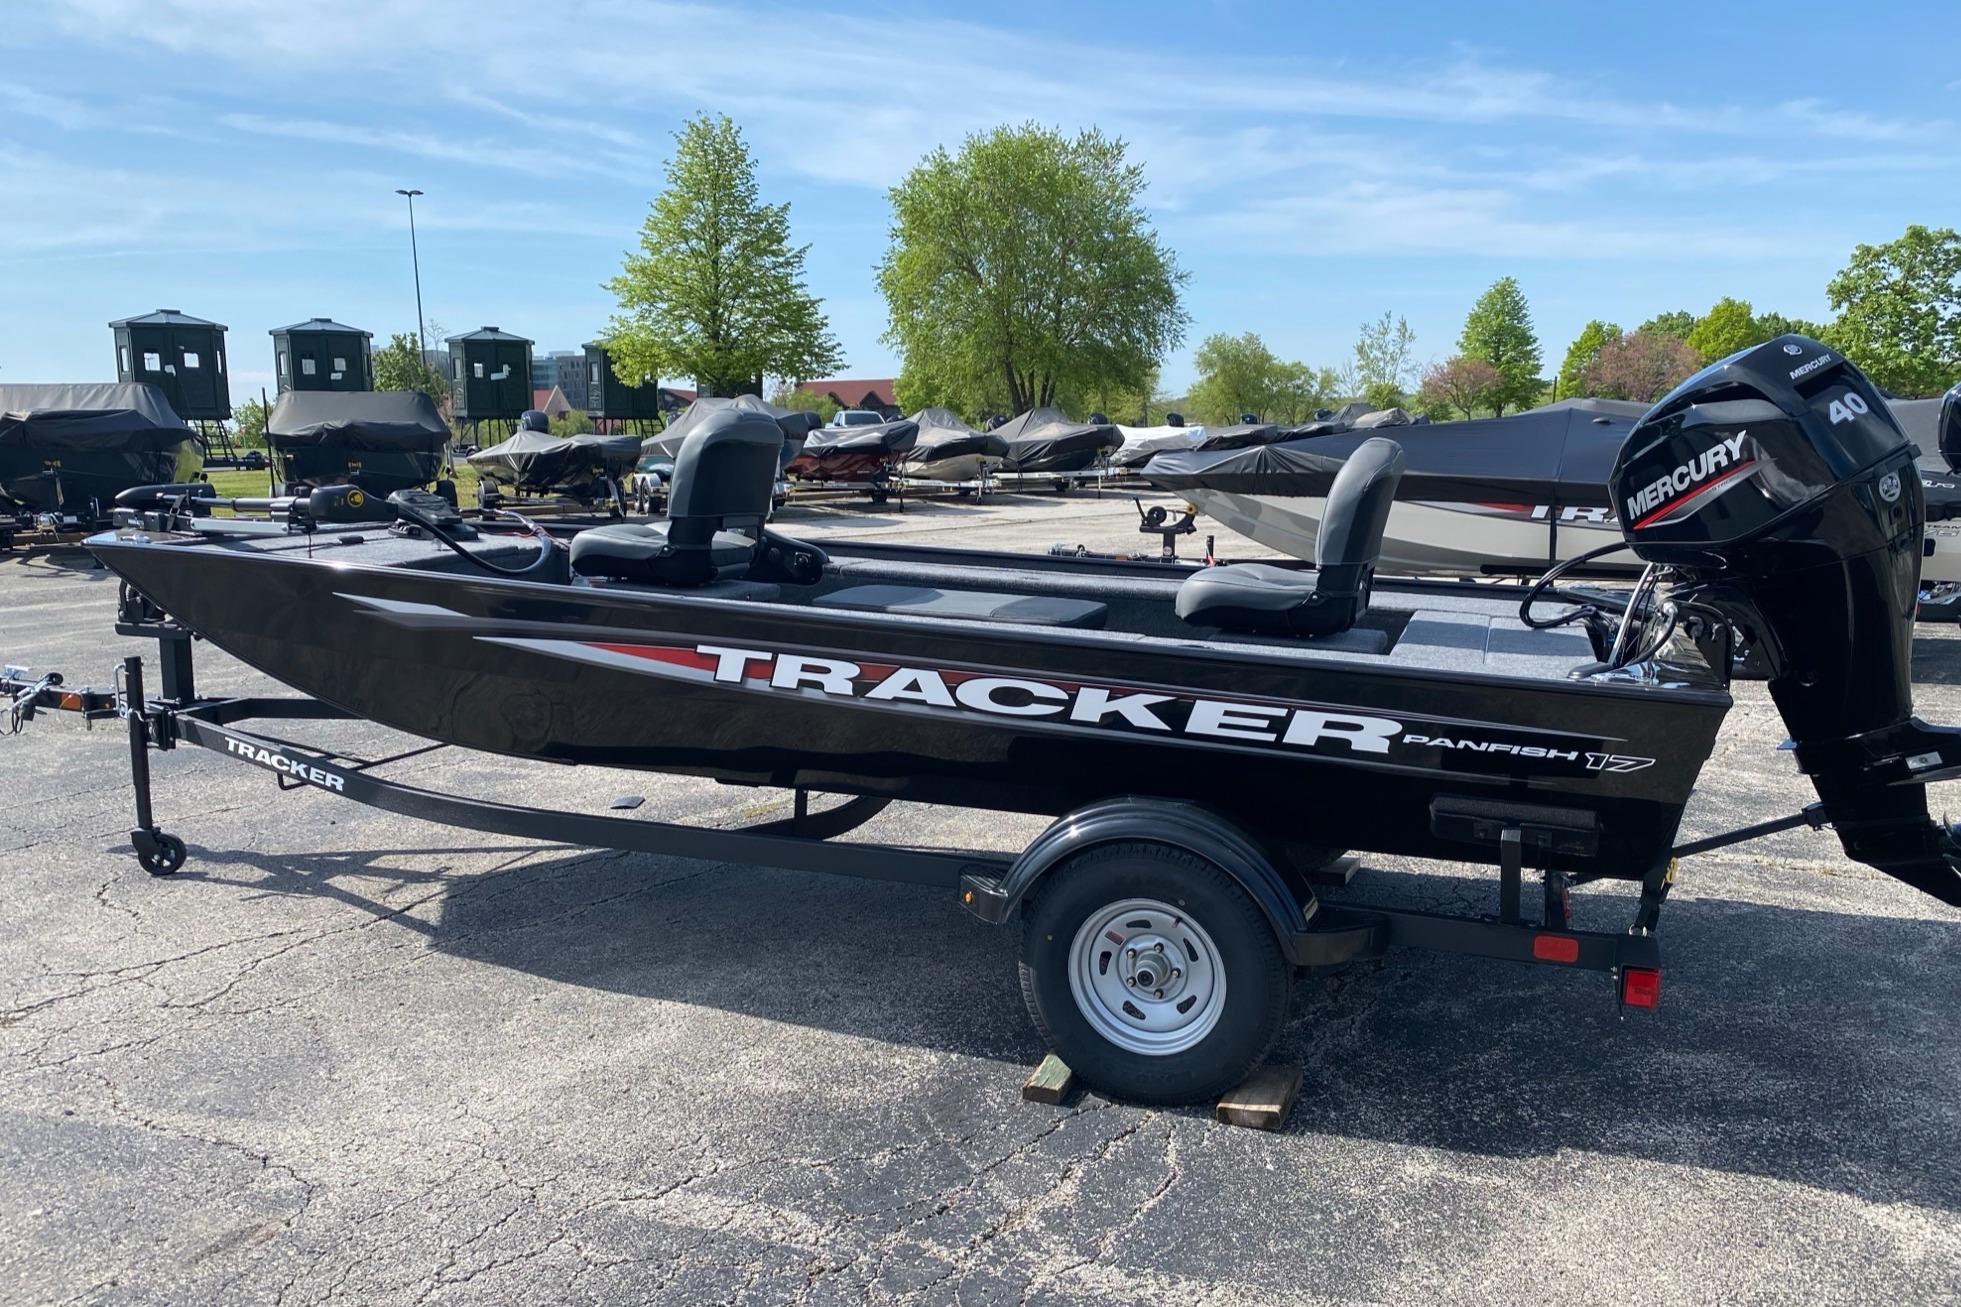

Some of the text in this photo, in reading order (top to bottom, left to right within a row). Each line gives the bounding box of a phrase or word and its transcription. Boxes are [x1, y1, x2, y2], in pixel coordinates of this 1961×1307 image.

[1789, 354, 1832, 380] MERCURY
[1828, 391, 1869, 425] 40
[1626, 429, 1747, 521] MERCURY
[695, 644, 1656, 773] TRACKER PANFISH 17
[224, 736, 345, 792] TRACKER
